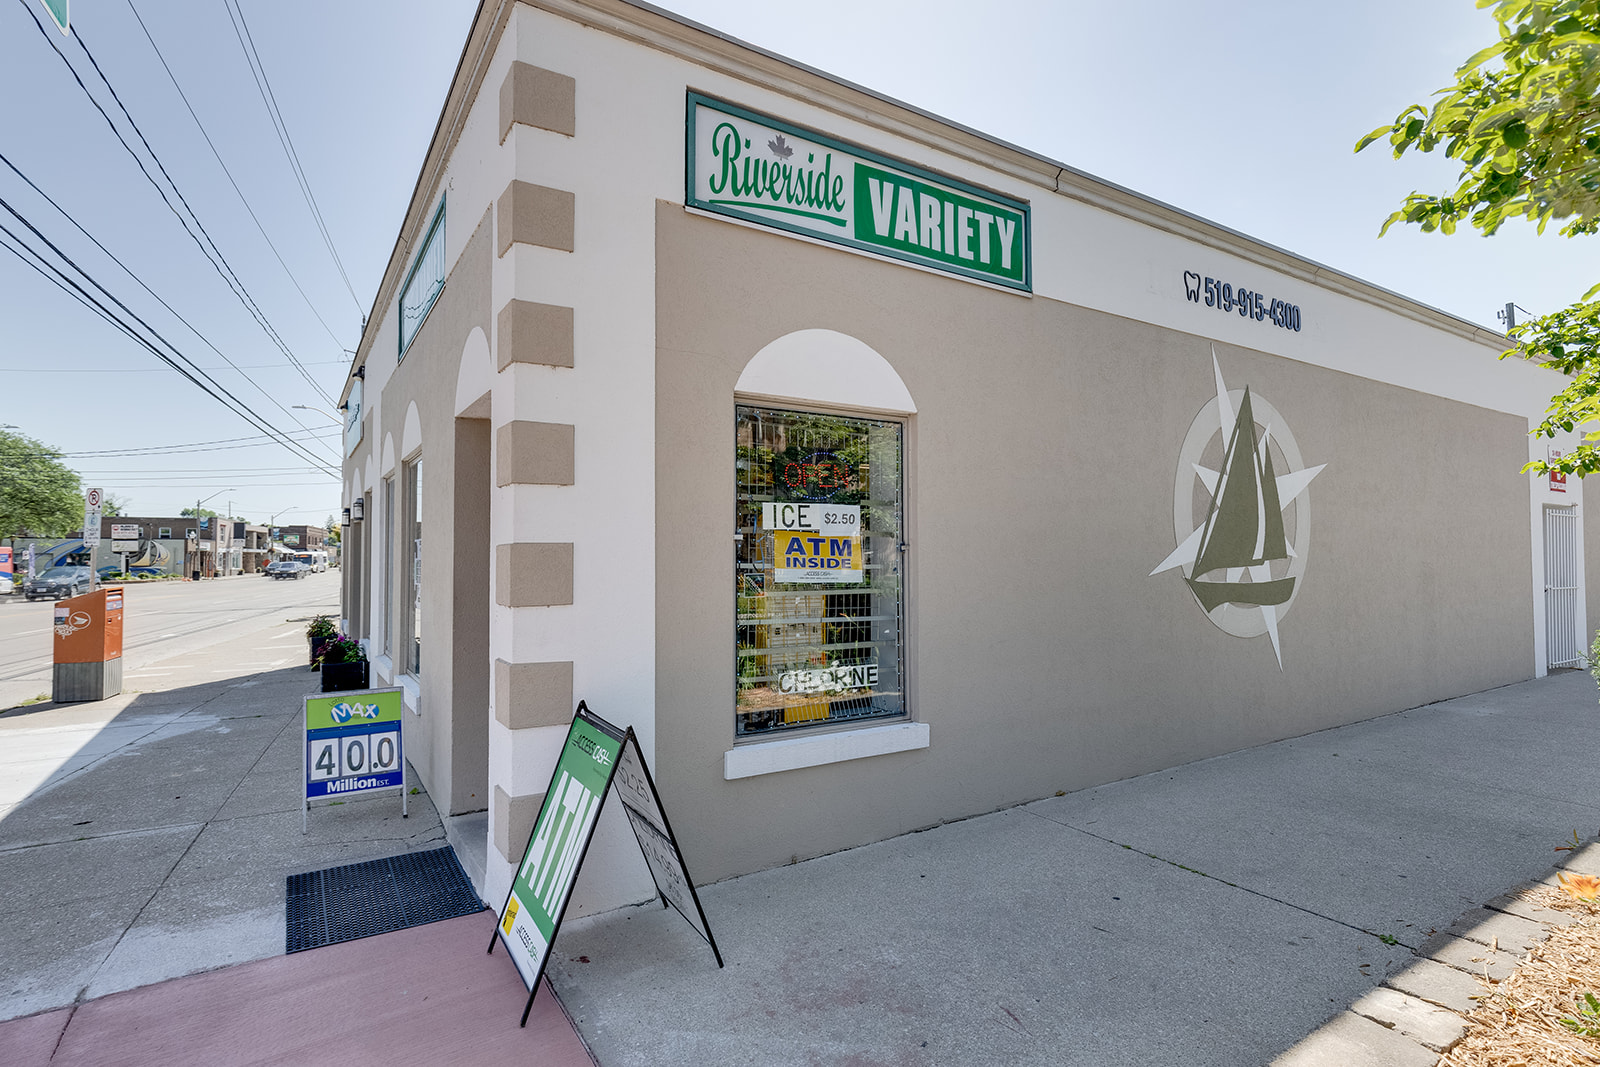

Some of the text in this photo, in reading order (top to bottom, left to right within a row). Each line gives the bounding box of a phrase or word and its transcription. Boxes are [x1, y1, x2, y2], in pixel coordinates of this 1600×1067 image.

[708, 121, 1017, 271] Riverside VARIETY
[1204, 276, 1302, 333] 519-915-4300
[784, 462, 850, 489] OPEN
[773, 504, 812, 529] ICE
[824, 512, 856, 525] $2.50
[784, 536, 853, 557] ATM
[785, 557, 852, 569] INSIDE
[779, 666, 878, 694] CHLORINE
[315, 737, 395, 776] 40.0
[574, 734, 597, 756] ACCESS
[592, 745, 611, 765] CASH
[327, 777, 390, 794] Million EST.
[520, 769, 601, 925] ATM
